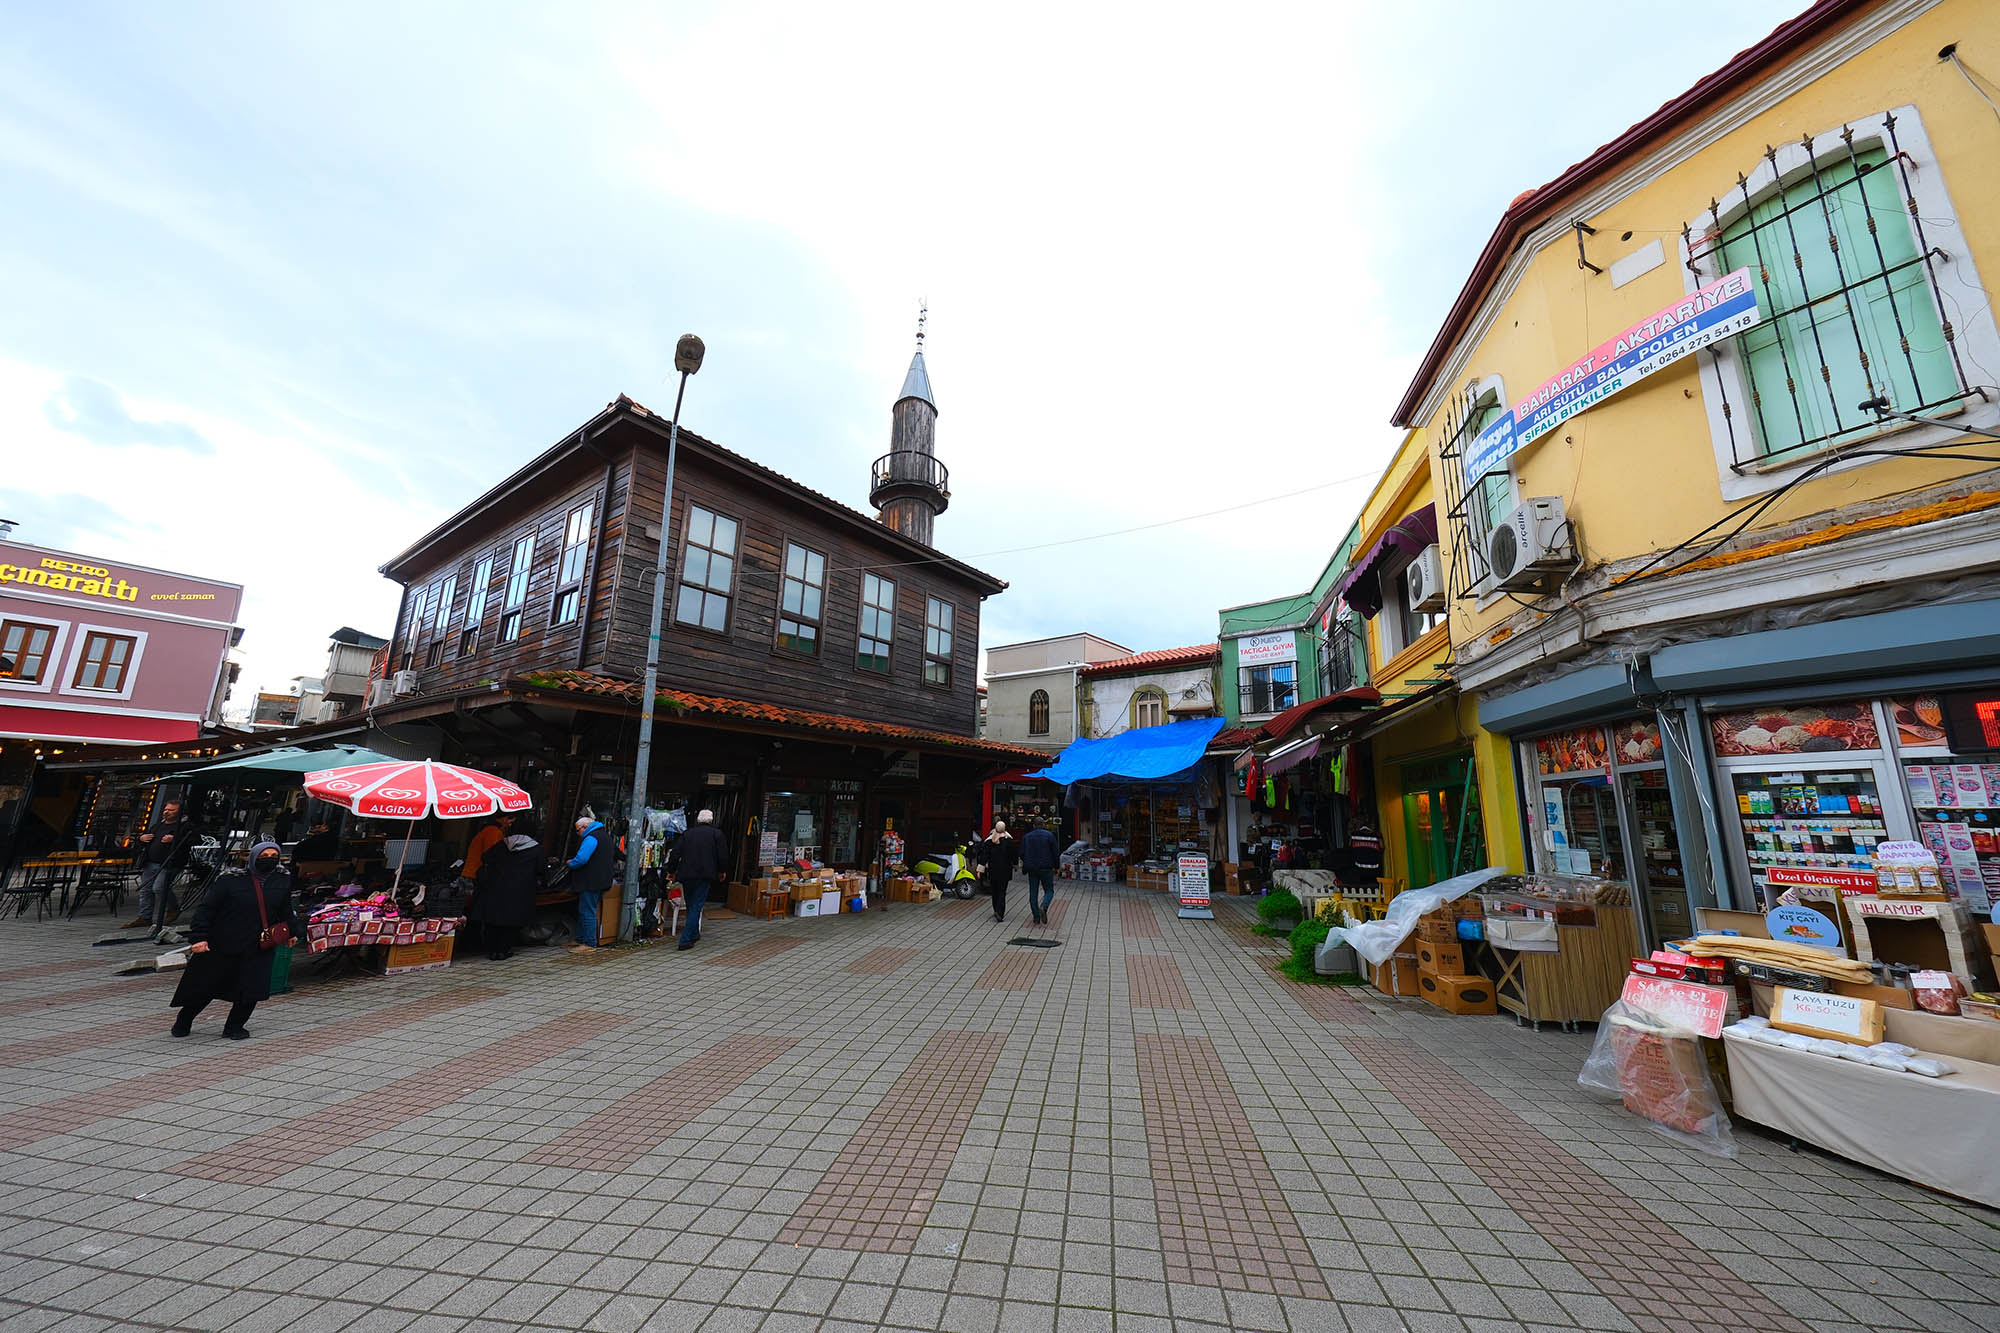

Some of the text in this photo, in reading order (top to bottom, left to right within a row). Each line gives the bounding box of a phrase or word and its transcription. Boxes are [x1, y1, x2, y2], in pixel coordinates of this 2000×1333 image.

[1519, 355, 1596, 418] BAHARAT
[1614, 275, 1745, 356] AKTARİYE
[1638, 315, 1752, 376] Tel. 0264 273 54 18
[1533, 406, 1551, 423] ARI
[1553, 383, 1586, 413] SÜTÜ
[1597, 361, 1627, 385] BAL
[1638, 321, 1699, 362] POLEN
[1561, 378, 1623, 420] BİTKİLER
[1517, 511, 1529, 548] arçelik
[40, 558, 109, 577] RETRO
[0, 564, 139, 602] çınaraltı
[150, 592, 215, 601] evvel zaman
[1776, 872, 1800, 882] Özel
[1803, 872, 1851, 885] Ölçüleri
[1855, 876, 1873, 886] İle
[1778, 914, 1819, 923] KIŞ ÇAYI
[1861, 903, 1925, 915] IHLAMUR
[1690, 990, 1711, 1004] EL
[1793, 994, 1855, 1009] KAYA TUZU
